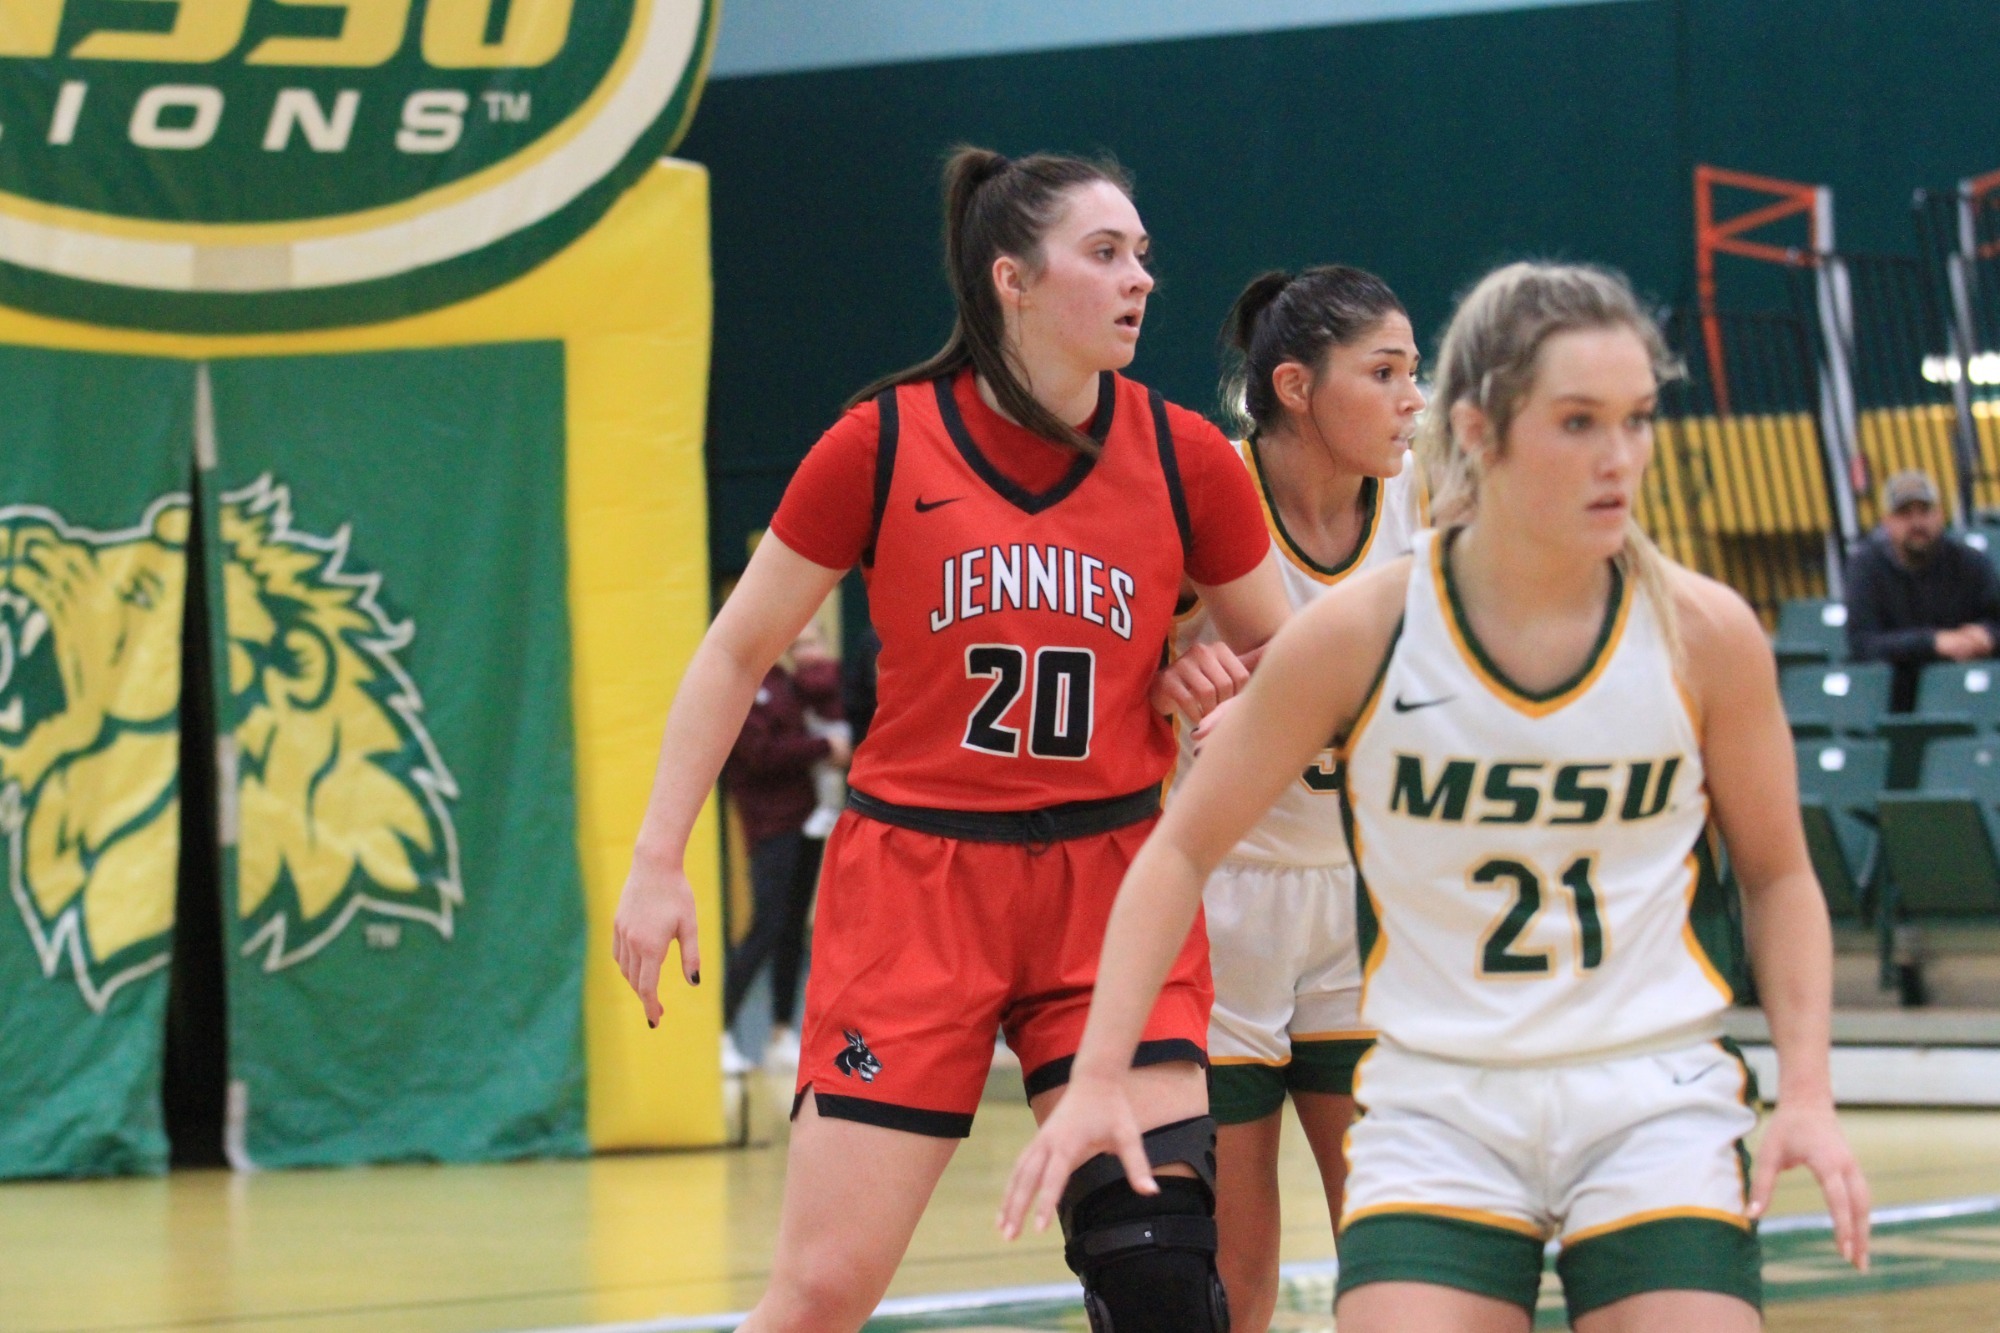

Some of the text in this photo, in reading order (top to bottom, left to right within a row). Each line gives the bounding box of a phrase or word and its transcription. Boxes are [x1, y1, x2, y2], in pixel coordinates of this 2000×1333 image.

[0, 79, 532, 154] IONS TM
[929, 542, 1135, 641] JENNIES
[960, 643, 1096, 762] 20
[1389, 752, 1685, 826] MSSU
[1466, 853, 1611, 980] 21
